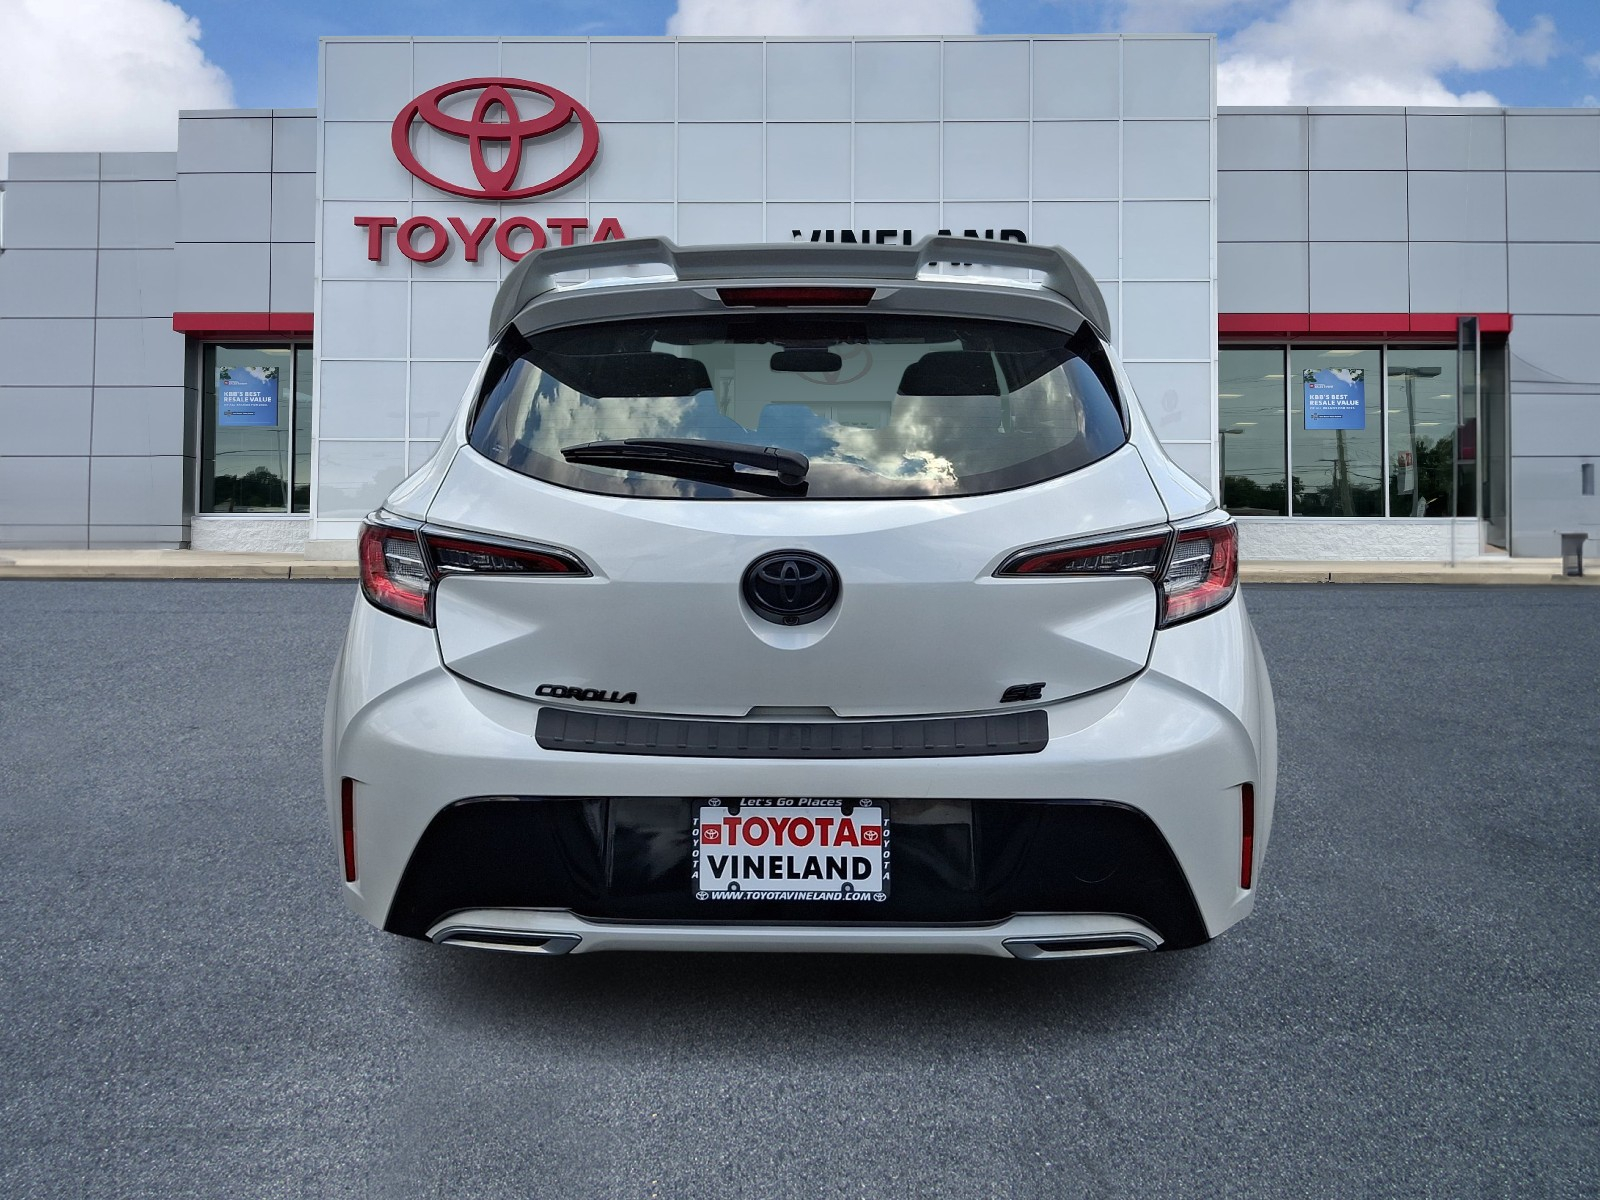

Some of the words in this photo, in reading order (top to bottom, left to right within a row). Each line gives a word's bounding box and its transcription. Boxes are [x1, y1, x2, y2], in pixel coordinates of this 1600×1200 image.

[534, 683, 637, 705] COROLLA
[740, 797, 772, 806] Let's
[776, 797, 794, 806] Go
[798, 797, 843, 807] Places
[723, 816, 860, 847] TOYOTA
[691, 817, 700, 879] TOYOTA
[881, 818, 891, 881] TOYOTA
[707, 855, 872, 880] VINELAND
[711, 891, 872, 901] WWW.TOYOTAVINELAND.COM
